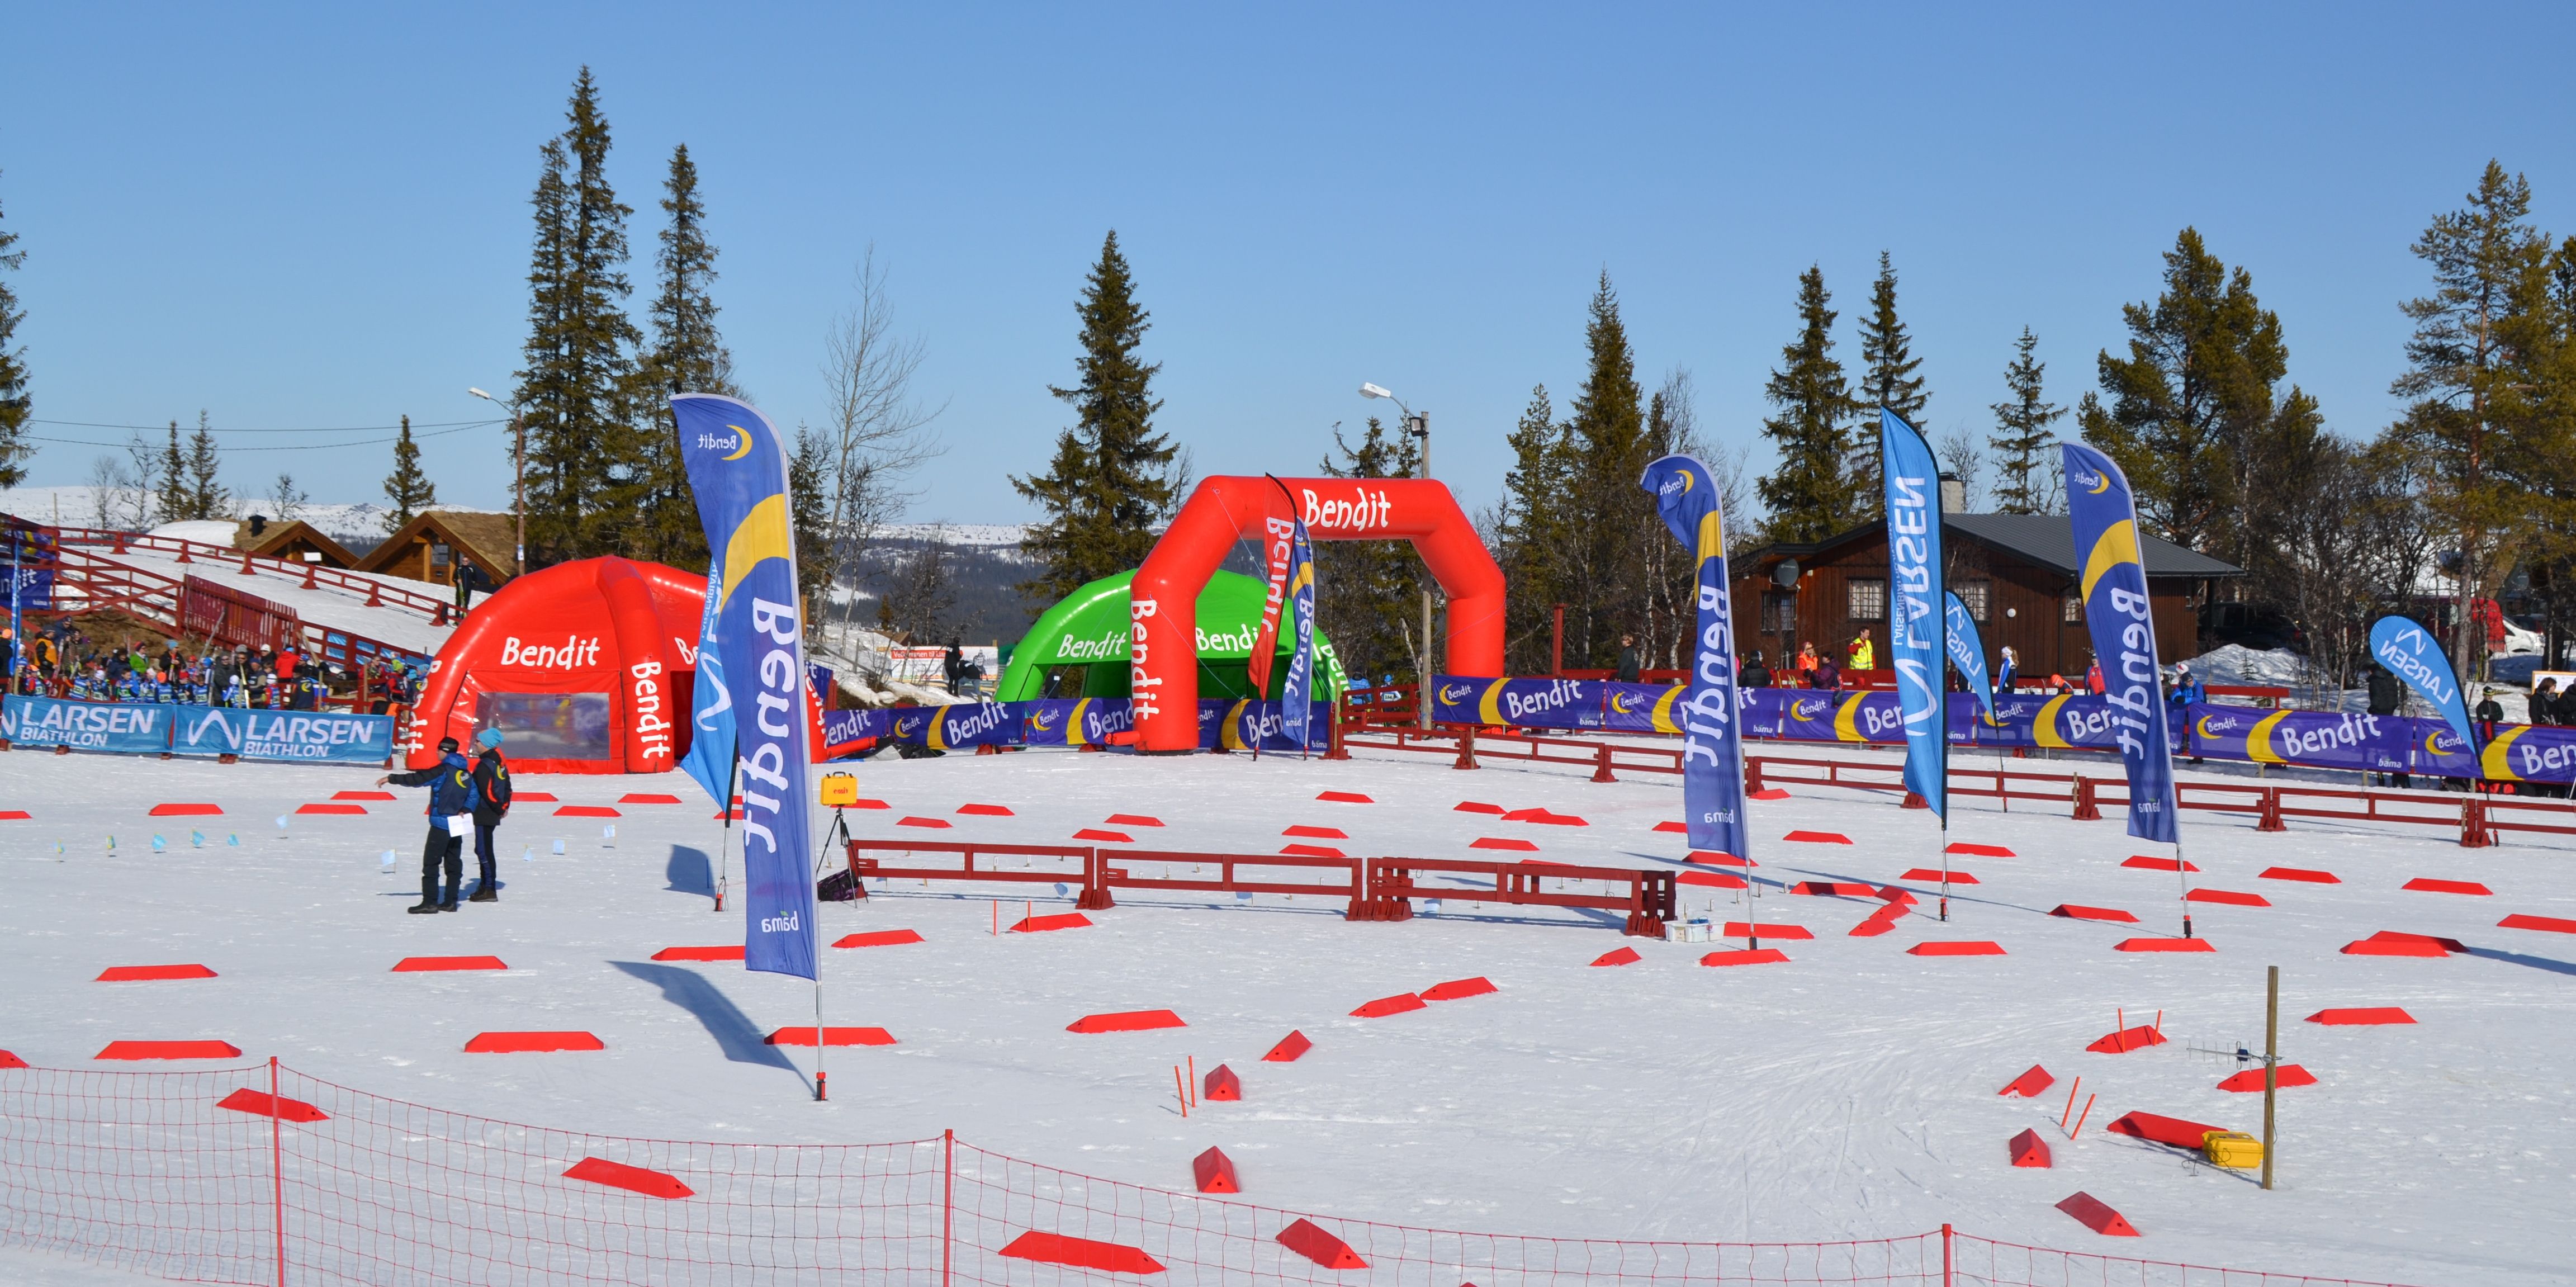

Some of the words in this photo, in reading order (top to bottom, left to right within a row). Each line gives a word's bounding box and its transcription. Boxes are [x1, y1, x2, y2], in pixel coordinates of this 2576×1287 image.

[1303, 487, 1391, 532] Bendit
[1057, 631, 1126, 659] Bendit
[1195, 623, 1258, 652] Bendi
[501, 635, 600, 670] Bendit
[1131, 599, 1163, 720] Bendit
[1447, 684, 1472, 699] Bendit
[1507, 679, 1582, 718] Bendit
[1621, 693, 1645, 707] Bendit
[22, 702, 155, 734] LARSEN
[631, 661, 670, 759] Bendit
[1040, 708, 1059, 725] Bendit
[1088, 698, 1133, 739] Bend
[1198, 709, 1214, 723] ndit
[1800, 699, 1826, 715] Bendit
[1995, 703, 2023, 720] Bendit
[246, 715, 374, 744] LARSEN
[827, 709, 871, 745] endit
[901, 716, 920, 732] Bendit
[948, 702, 1008, 745] Bendit
[1753, 725, 1773, 734] bama
[2207, 717, 2237, 732] Bendit
[2281, 713, 2381, 756] Bendit
[20, 727, 108, 746] BIATHLON
[1311, 740, 1328, 749] bama
[2437, 733, 2466, 749] Bend
[243, 741, 330, 758] BIATHLON
[2521, 744, 2576, 775] Ben
[2378, 758, 2402, 768] bama
